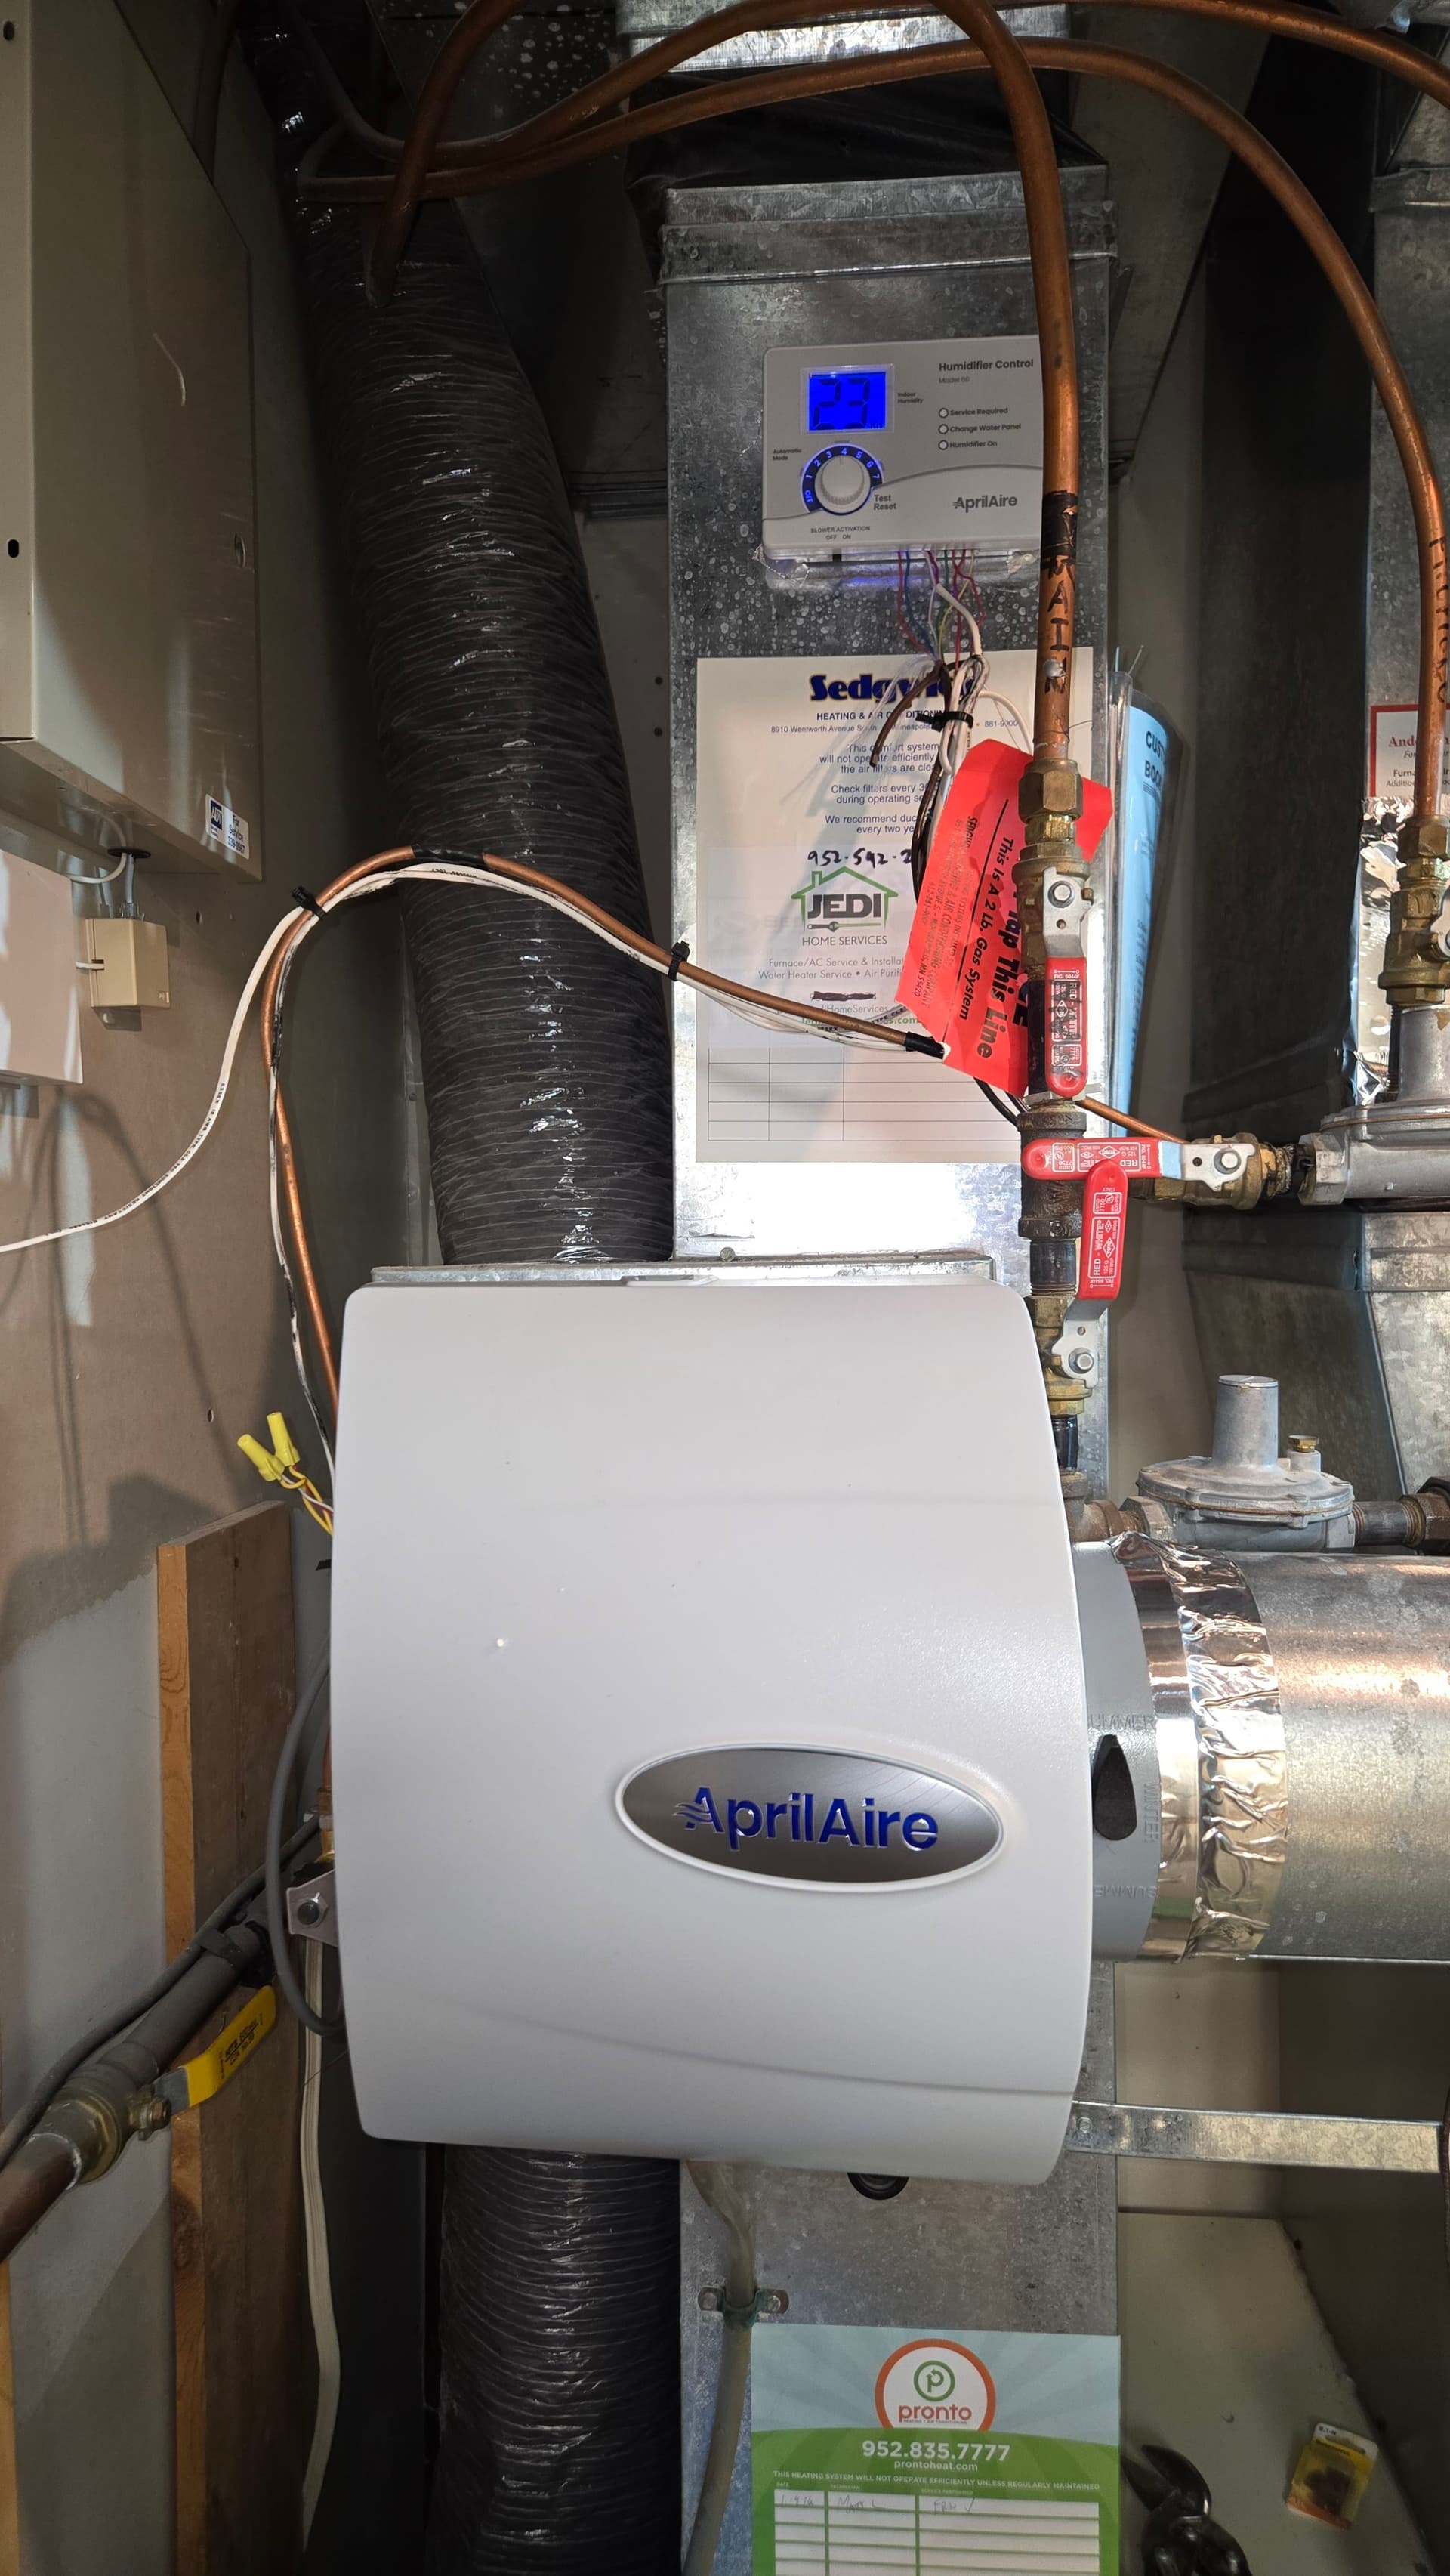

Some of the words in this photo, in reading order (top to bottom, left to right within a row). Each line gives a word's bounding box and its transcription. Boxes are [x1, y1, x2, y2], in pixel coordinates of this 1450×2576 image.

[939, 360, 992, 372] Humidifier
[995, 359, 1034, 369] Control
[813, 378, 871, 430] 23
[976, 408, 1009, 416] Required
[856, 450, 863, 459] 5
[874, 494, 891, 502] Test
[952, 495, 1018, 513] AprilAire
[873, 502, 897, 511] Reset
[868, 712, 883, 720] AR
[1146, 730, 1165, 762] CUST
[1389, 735, 1417, 747] And
[848, 743, 867, 753] This
[907, 743, 939, 753] system
[892, 753, 935, 764] efficiently
[841, 765, 855, 774] the
[858, 765, 870, 774] air
[831, 784, 860, 793] Check
[863, 784, 887, 793] filters
[890, 785, 916, 794] every
[836, 795, 865, 805] during
[868, 794, 911, 805] operating
[825, 815, 841, 823] We
[843, 814, 897, 823] recommend
[899, 814, 917, 823] duc
[856, 826, 881, 835] every
[884, 825, 901, 833] two
[997, 836, 1014, 866] This
[992, 867, 1004, 881] Is
[988, 882, 1000, 897] A
[807, 893, 882, 919] JEDI
[985, 898, 997, 911] 2
[979, 911, 993, 931] Lb.
[802, 936, 836, 946] HOME
[839, 935, 888, 945] SERVICES
[974, 937, 988, 962] Gas
[769, 958, 823, 968] Furnace/AC
[826, 957, 858, 967] Service
[861, 957, 868, 965] &
[918, 962, 927, 975] MN
[758, 971, 785, 980] Water
[788, 970, 818, 979] Heater
[820, 969, 852, 979] Service
[864, 969, 878, 978] Air
[990, 956, 1020, 1003] This
[914, 975, 925, 997] 55420
[1069, 983, 1077, 999] RED
[959, 968, 980, 1020] System
[976, 1006, 1007, 1058] Line
[1119, 1159, 1138, 1167] RED
[1093, 1258, 1101, 1276] RED
[1088, 1713, 1157, 1731] UMMER
[672, 1786, 939, 1852] AprilAire
[1143, 1782, 1159, 1844] WINTER
[1094, 1885, 1158, 1898] SUMME
[899, 2404, 972, 2423] pronto
[862, 2440, 1010, 2462] 952.835.7777
[894, 2460, 978, 2472] prontoheat.com
[791, 2471, 823, 2479] HEATING
[929, 2477, 976, 2485] EFFICIENTLY
[1007, 2481, 1051, 2489] REGULARLY
